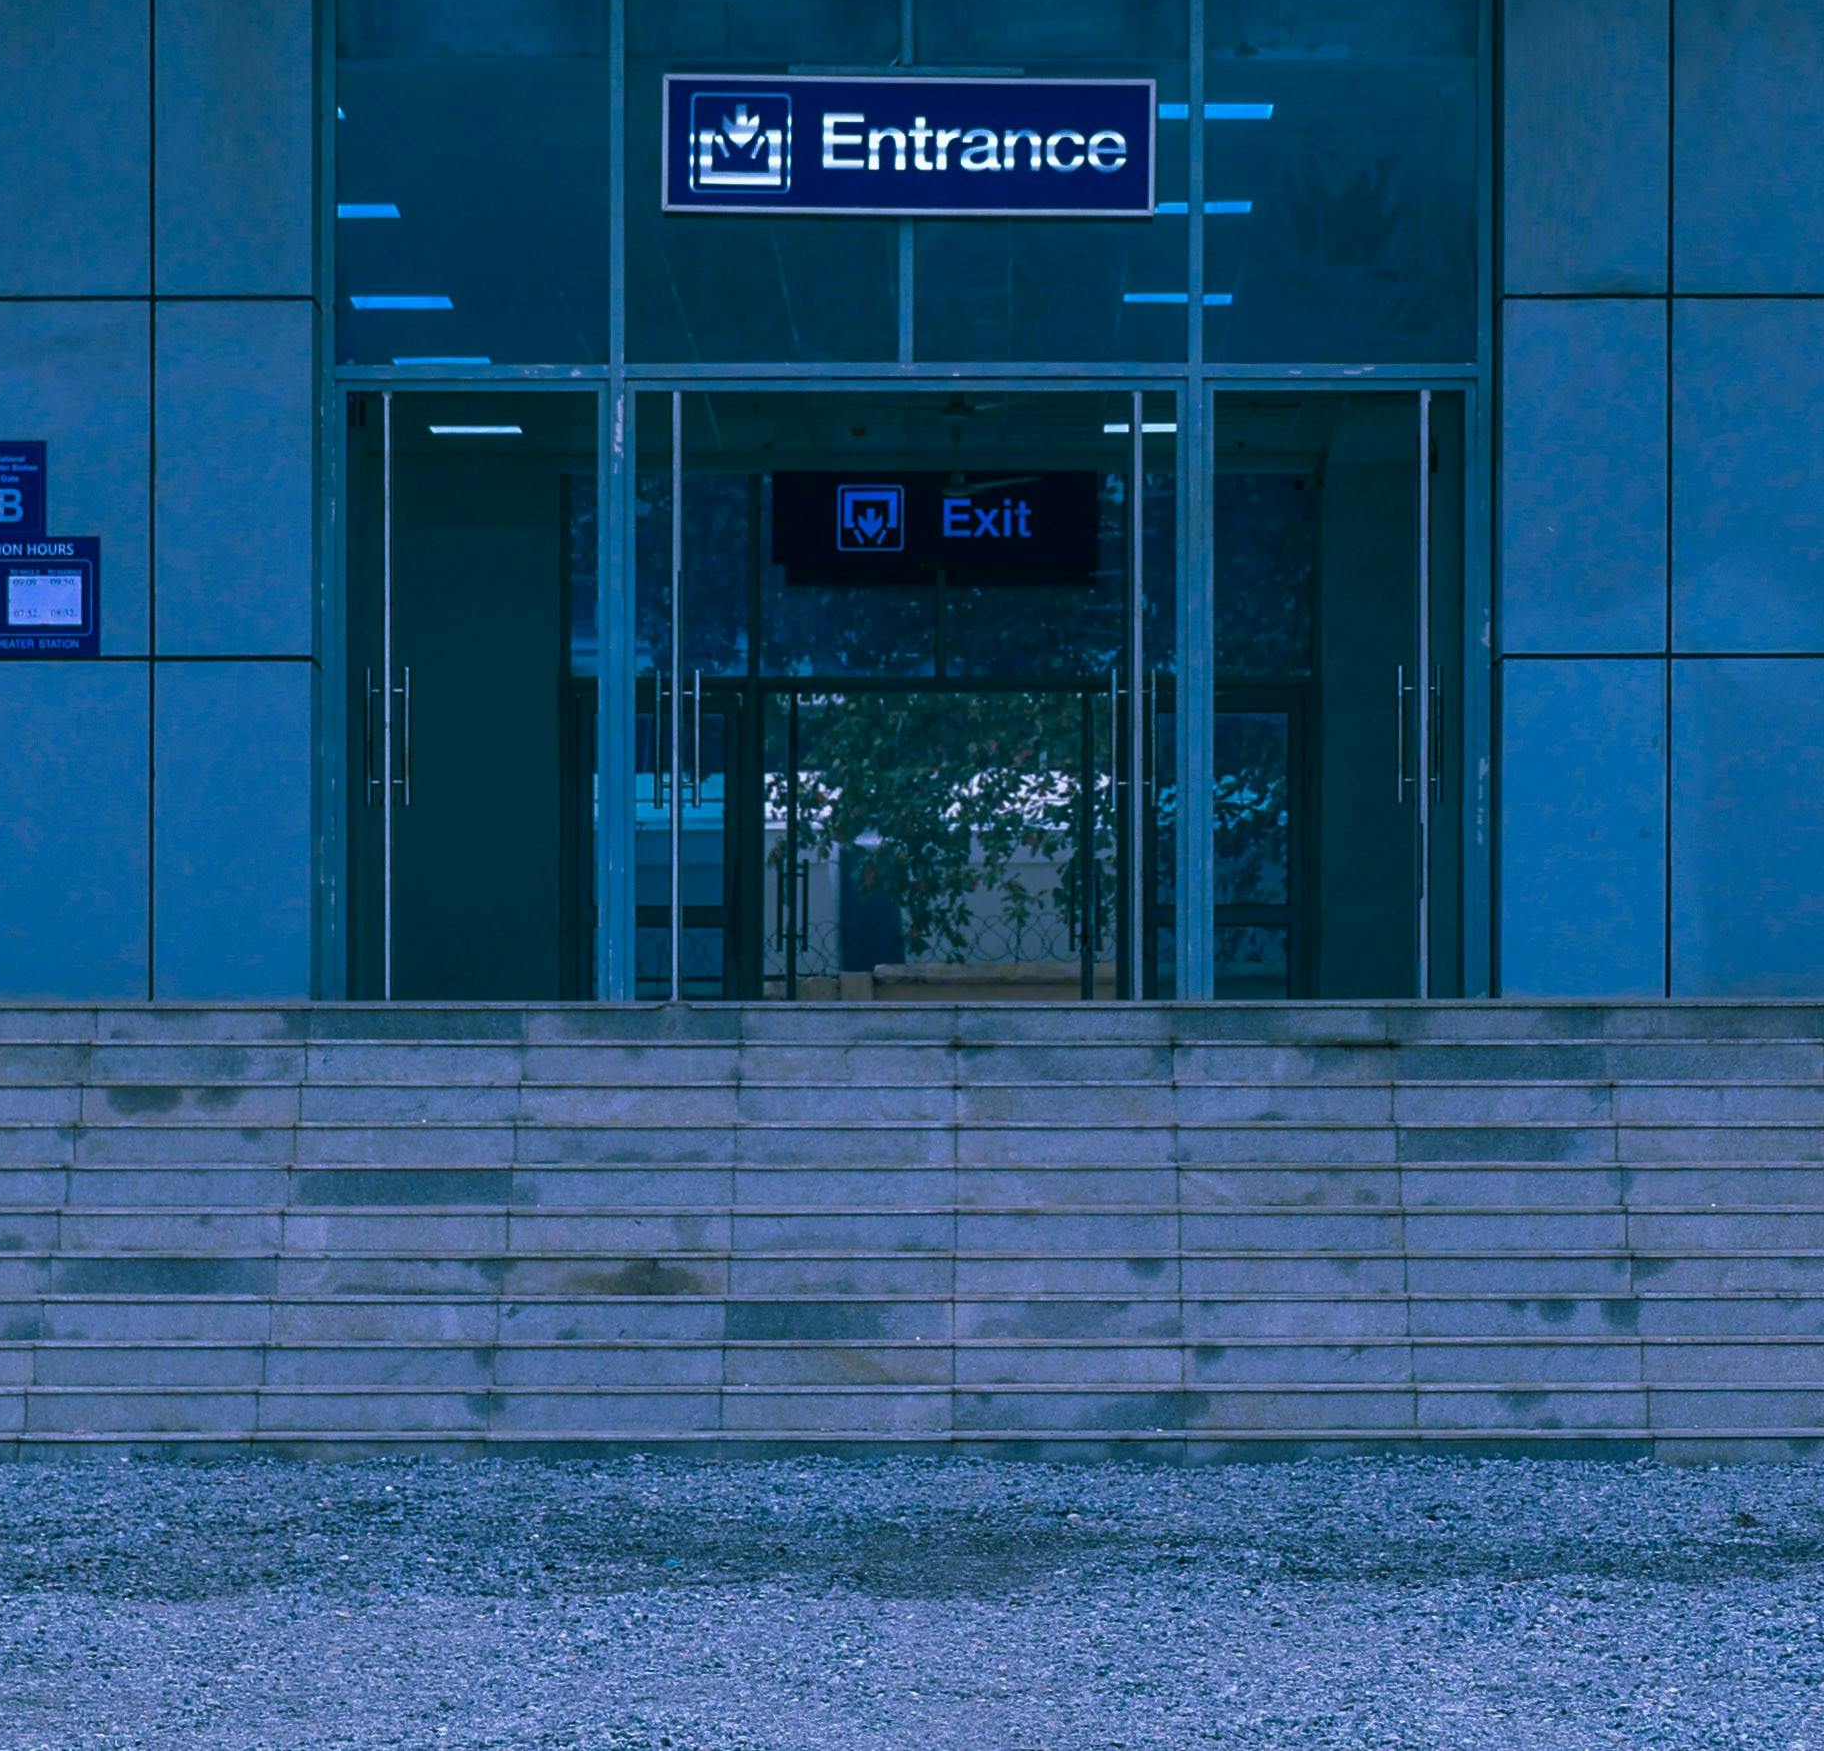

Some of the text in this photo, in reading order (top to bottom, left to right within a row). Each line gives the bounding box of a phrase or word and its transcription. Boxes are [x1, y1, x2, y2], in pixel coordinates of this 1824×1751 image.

[822, 112, 1127, 172] Entrance
[0, 475, 19, 483] Gate
[943, 499, 1031, 537] Exit
[27, 544, 74, 556] HOURS
[39, 639, 79, 649] STATION
